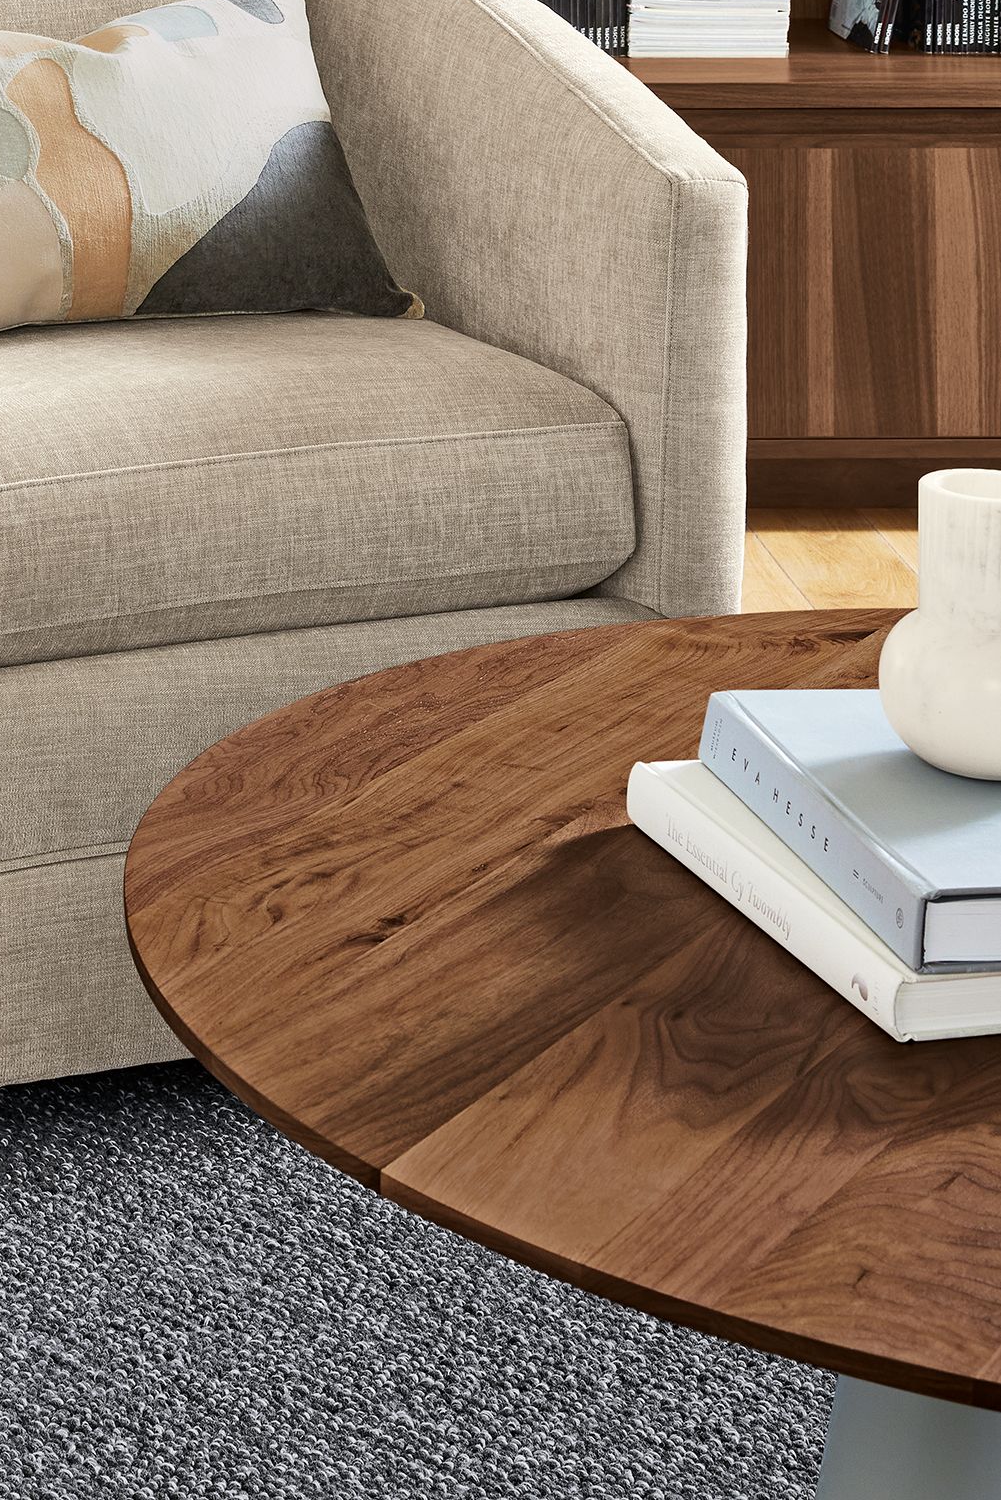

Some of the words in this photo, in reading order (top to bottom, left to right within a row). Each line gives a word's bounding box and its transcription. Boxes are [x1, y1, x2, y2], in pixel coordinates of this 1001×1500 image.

[874, 22, 883, 44] TASCHEN
[884, 23, 893, 45] TASCHEN
[731, 747, 760, 785] EVA
[772, 788, 829, 852] HESSE
[665, 812, 684, 847] The
[686, 831, 728, 884] Essential
[730, 869, 744, 902] Cy
[748, 881, 792, 942] Twombly
